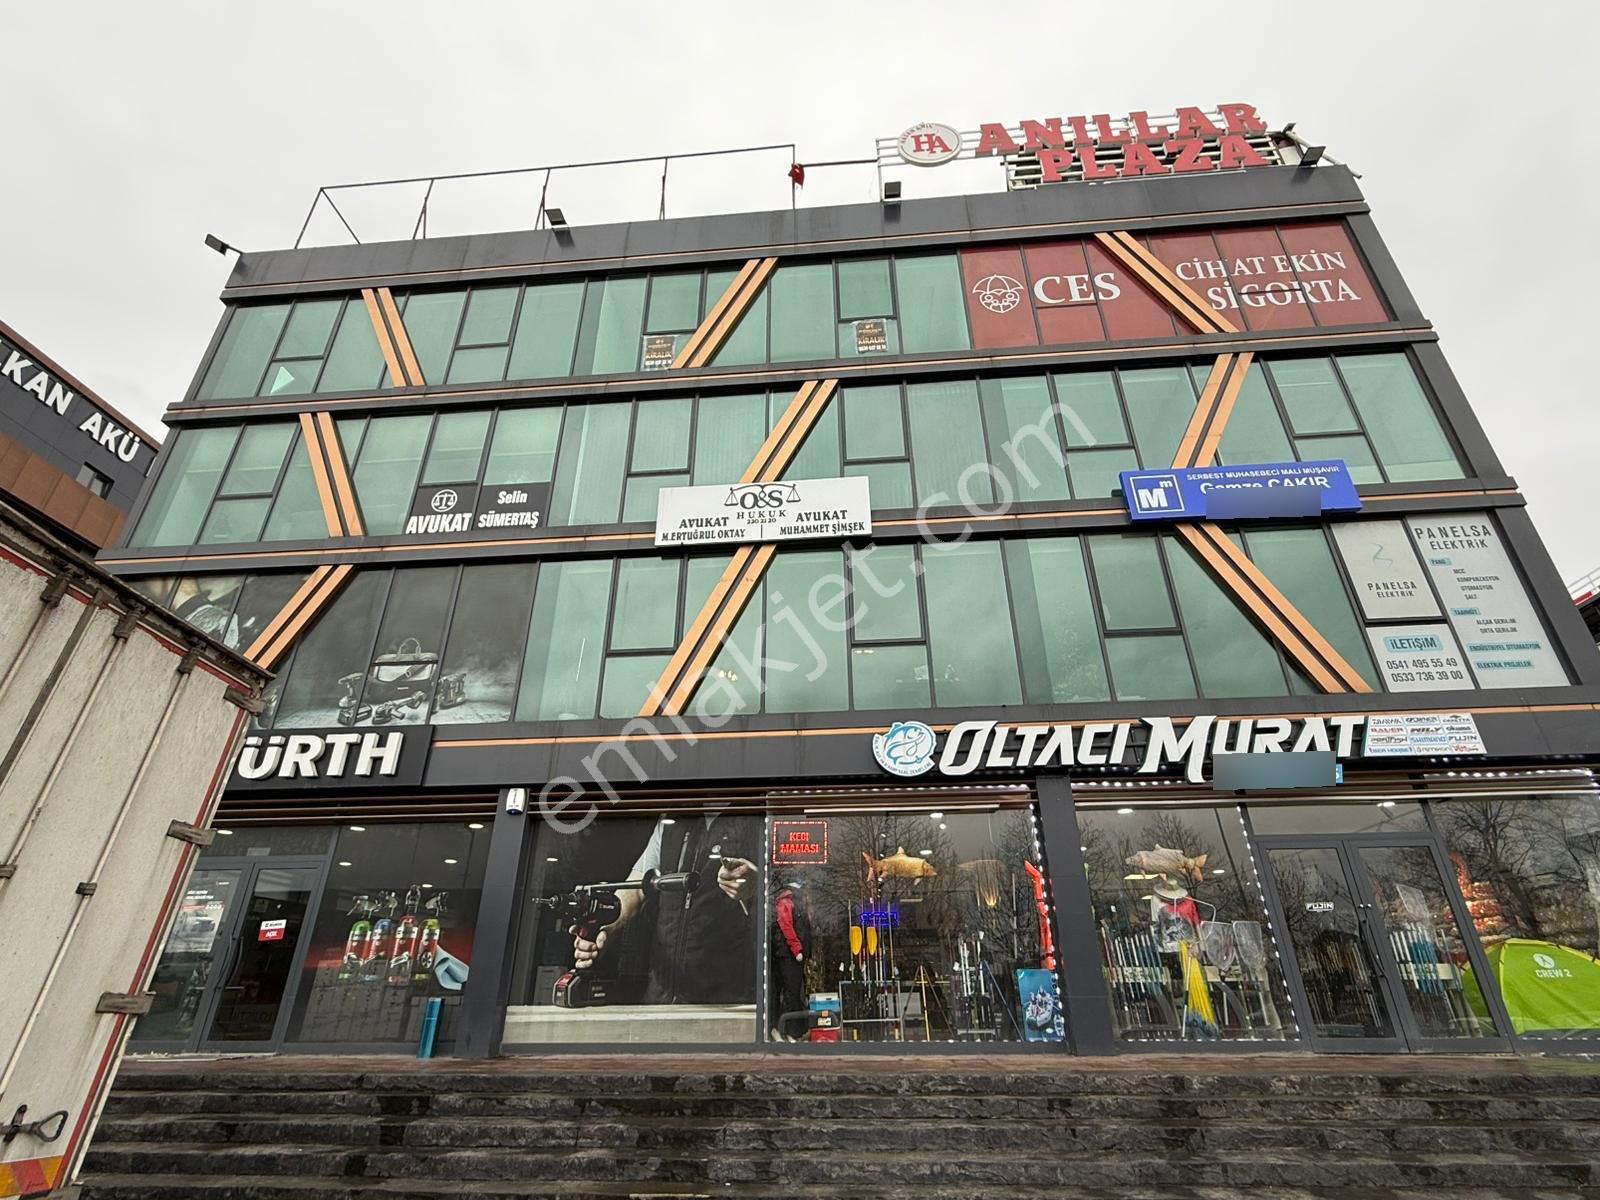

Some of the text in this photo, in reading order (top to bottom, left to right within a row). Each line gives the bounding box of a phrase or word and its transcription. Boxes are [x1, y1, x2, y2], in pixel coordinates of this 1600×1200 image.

[976, 103, 1268, 155] ANILLAR
[911, 133, 953, 154] HA
[1036, 135, 1268, 183] PLAZA
[1176, 249, 1347, 280] CİHAT EKİN
[1034, 272, 1121, 304] CES
[1211, 277, 1362, 311] SİGORTA
[0, 338, 140, 463] KAN AKÜ
[497, 490, 528, 504] Selin
[740, 489, 783, 510] O&S
[478, 510, 540, 529] SÜMERTAŞ
[737, 509, 787, 519] HUKUK
[795, 509, 848, 522] AVUKAT
[405, 513, 473, 534] AVUKAT
[679, 516, 730, 529] AVUKAT
[779, 521, 866, 536] MUHAMMET ŞİMŞEK
[717, 528, 746, 540] OKTAY
[1414, 525, 1492, 540] PANELSA
[1429, 539, 1489, 550] ELEKTRİK
[1367, 581, 1417, 591] PANELSA
[1390, 636, 1437, 651] İLETİŞİM
[1386, 657, 1458, 670] 0541 495 55 49
[1391, 670, 1464, 682] 0533 736 39 00
[237, 732, 404, 780] ÜRTH
[938, 720, 1132, 776] OLTACI
[1135, 715, 1365, 784] MURAT
[1535, 968, 1573, 978] CREW 2
